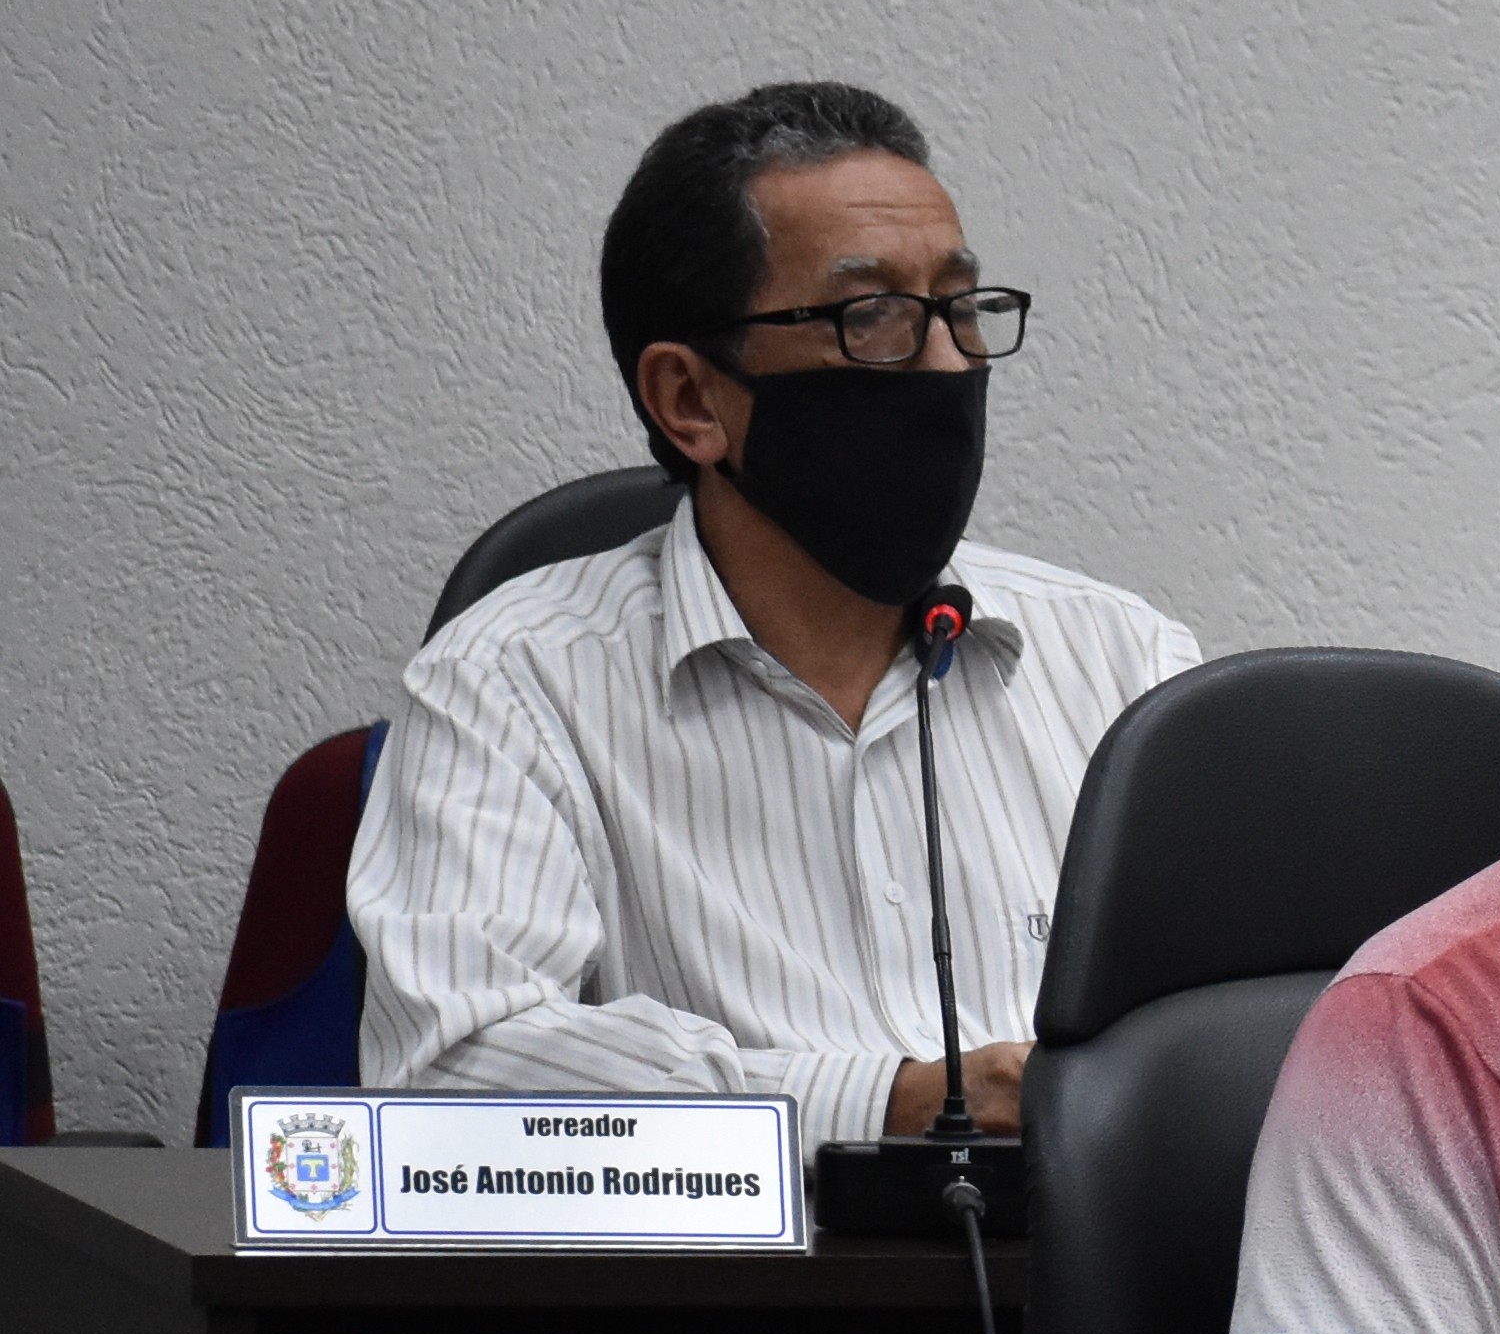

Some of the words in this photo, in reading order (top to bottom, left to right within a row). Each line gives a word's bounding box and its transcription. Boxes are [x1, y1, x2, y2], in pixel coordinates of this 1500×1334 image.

[522, 1113, 638, 1138] vereador
[400, 1164, 469, 1194] José
[476, 1165, 595, 1195] Antonio
[602, 1166, 761, 1199] Rodrigues
